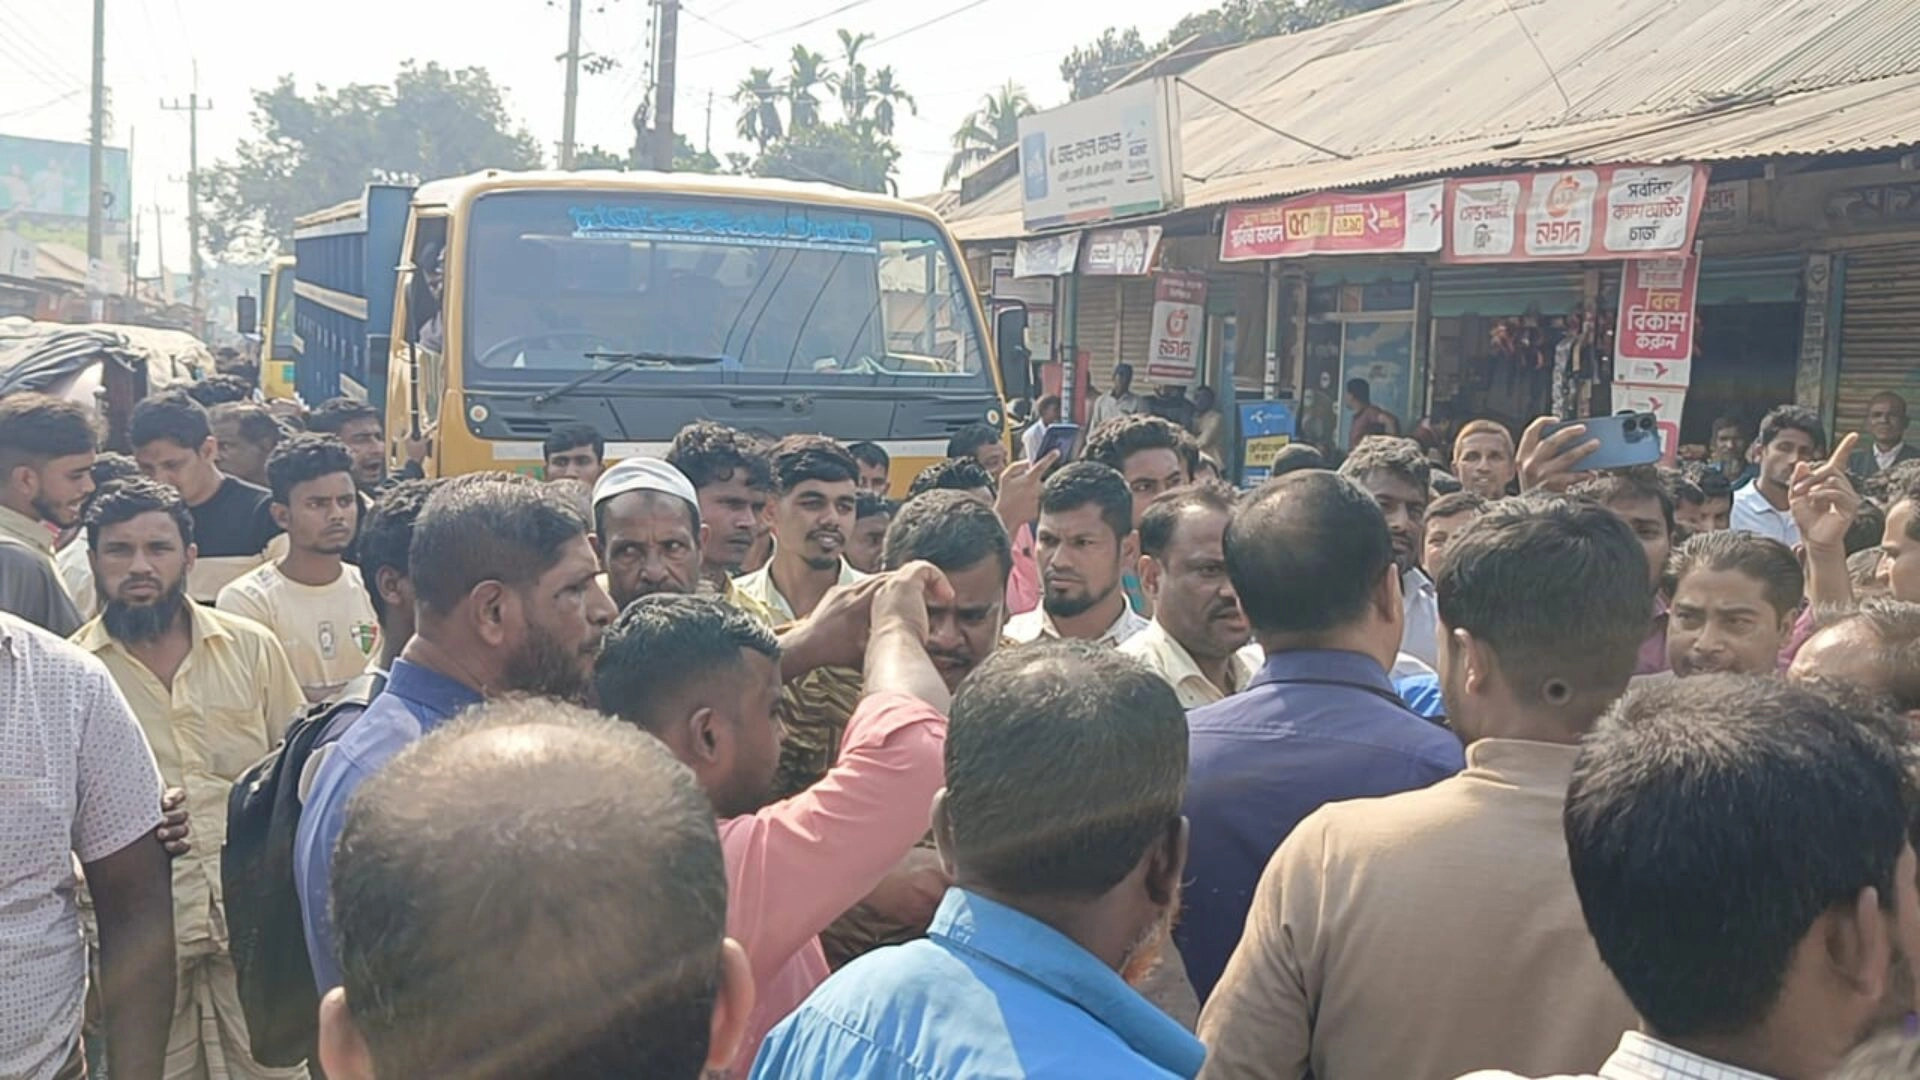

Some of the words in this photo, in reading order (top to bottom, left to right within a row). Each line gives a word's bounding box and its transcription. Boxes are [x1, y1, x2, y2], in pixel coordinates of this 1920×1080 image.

[1536, 220, 1581, 245] নগদ
[1629, 220, 1661, 240] চার্জ
[1646, 287, 1683, 312] বিল
[1627, 305, 1689, 332] বিকাশ
[1635, 332, 1680, 351] করুন
